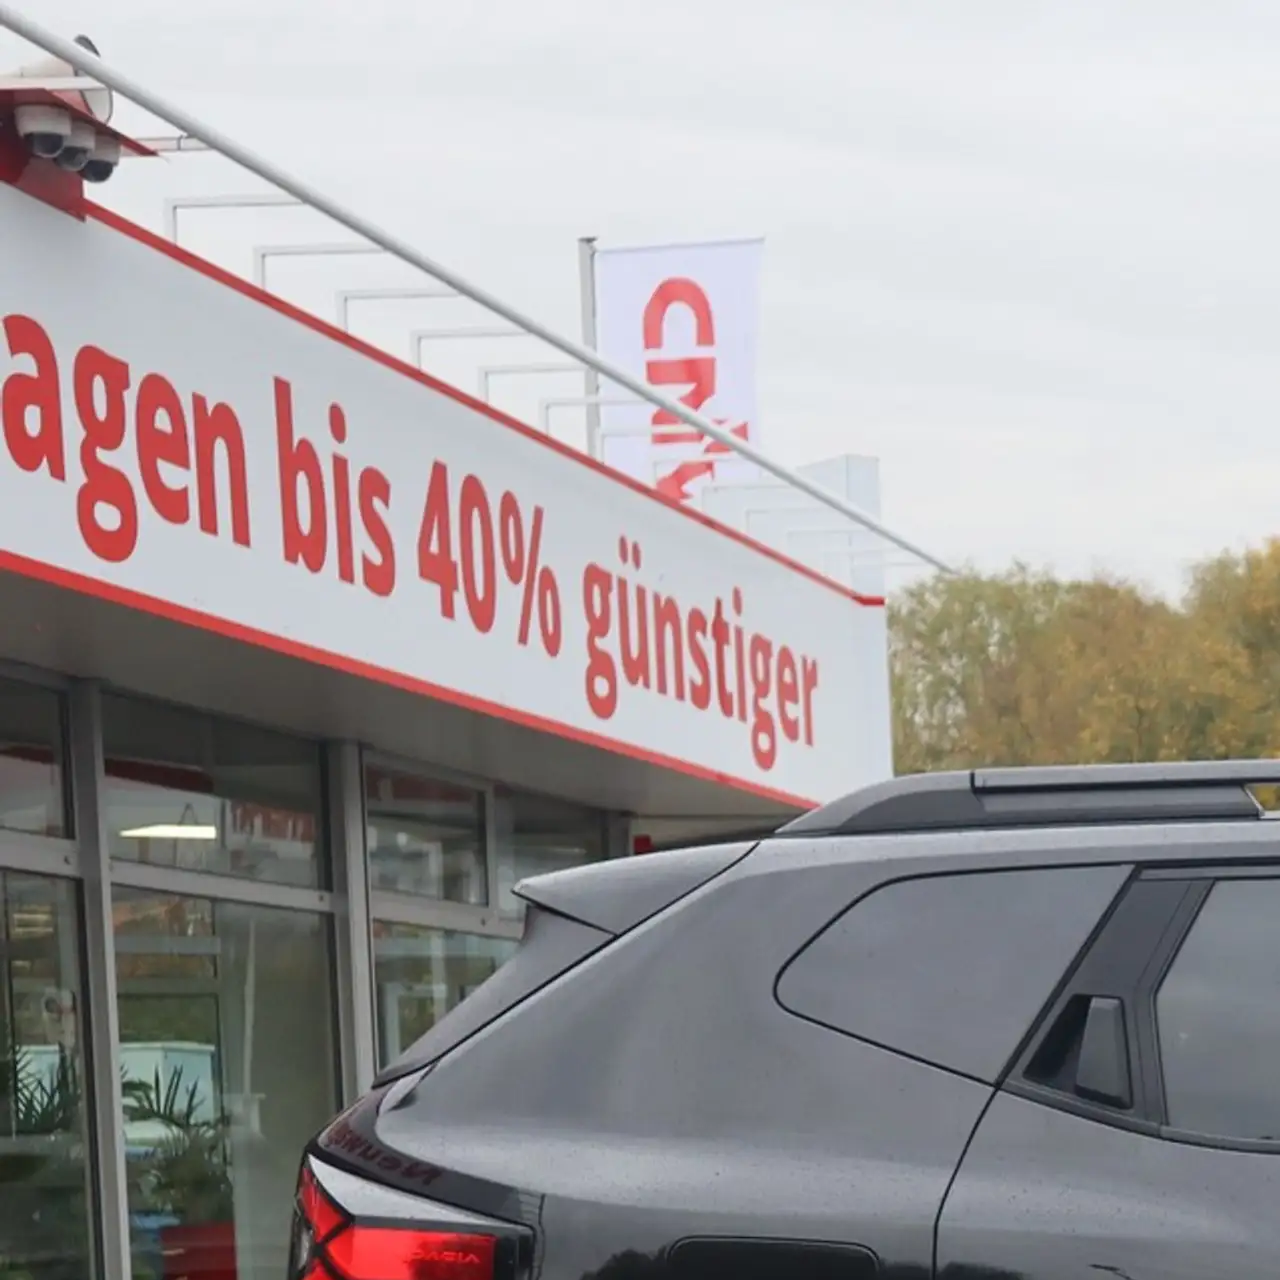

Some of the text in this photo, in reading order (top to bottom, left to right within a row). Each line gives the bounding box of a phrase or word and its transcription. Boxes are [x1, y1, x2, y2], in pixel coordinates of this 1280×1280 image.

[274, 377, 397, 598] bis
[418, 460, 562, 657] 40%
[582, 537, 818, 771] günstiger
[411, 1250, 481, 1264] DACIA
